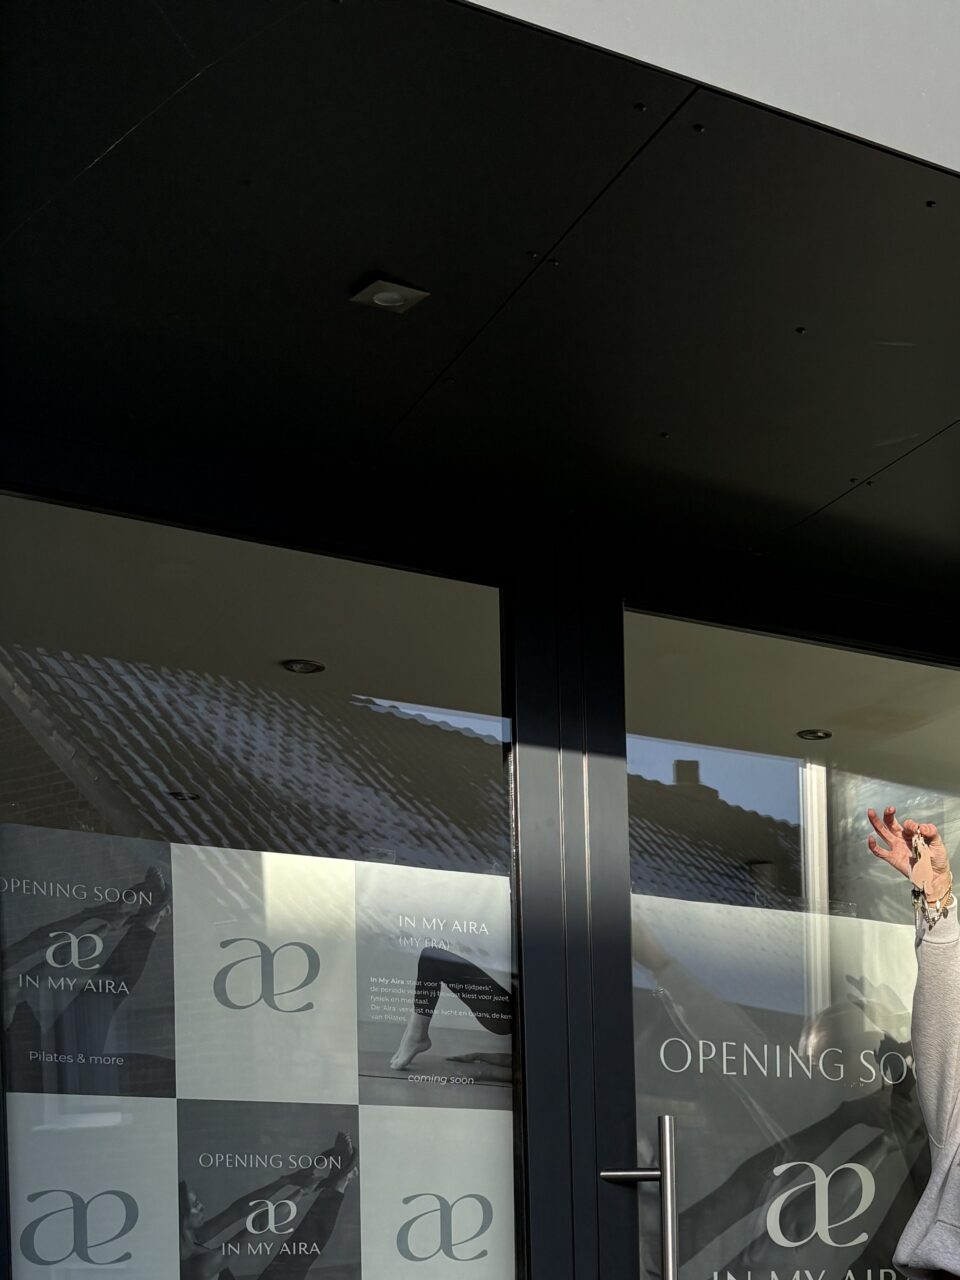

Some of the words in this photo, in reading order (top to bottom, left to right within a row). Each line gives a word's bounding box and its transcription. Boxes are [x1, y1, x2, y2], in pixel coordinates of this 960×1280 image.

[94, 886, 153, 905] SOON
[399, 915, 416, 928] IN
[422, 917, 446, 931] MY
[452, 920, 489, 935] AIRA
[18, 974, 40, 988] IN
[48, 976, 77, 991] MY
[84, 979, 130, 995] AIRA
[28, 1050, 73, 1065] Pilates
[77, 1054, 86, 1065] &
[89, 1057, 124, 1066] more
[660, 1037, 845, 1082] OPENING
[408, 1074, 447, 1085] coming
[450, 1076, 474, 1084] soon
[198, 1152, 283, 1169] OPENING
[289, 1153, 342, 1169] SOON
[222, 1242, 242, 1256] IN
[247, 1242, 274, 1256] MY
[280, 1242, 321, 1256] AIRA
